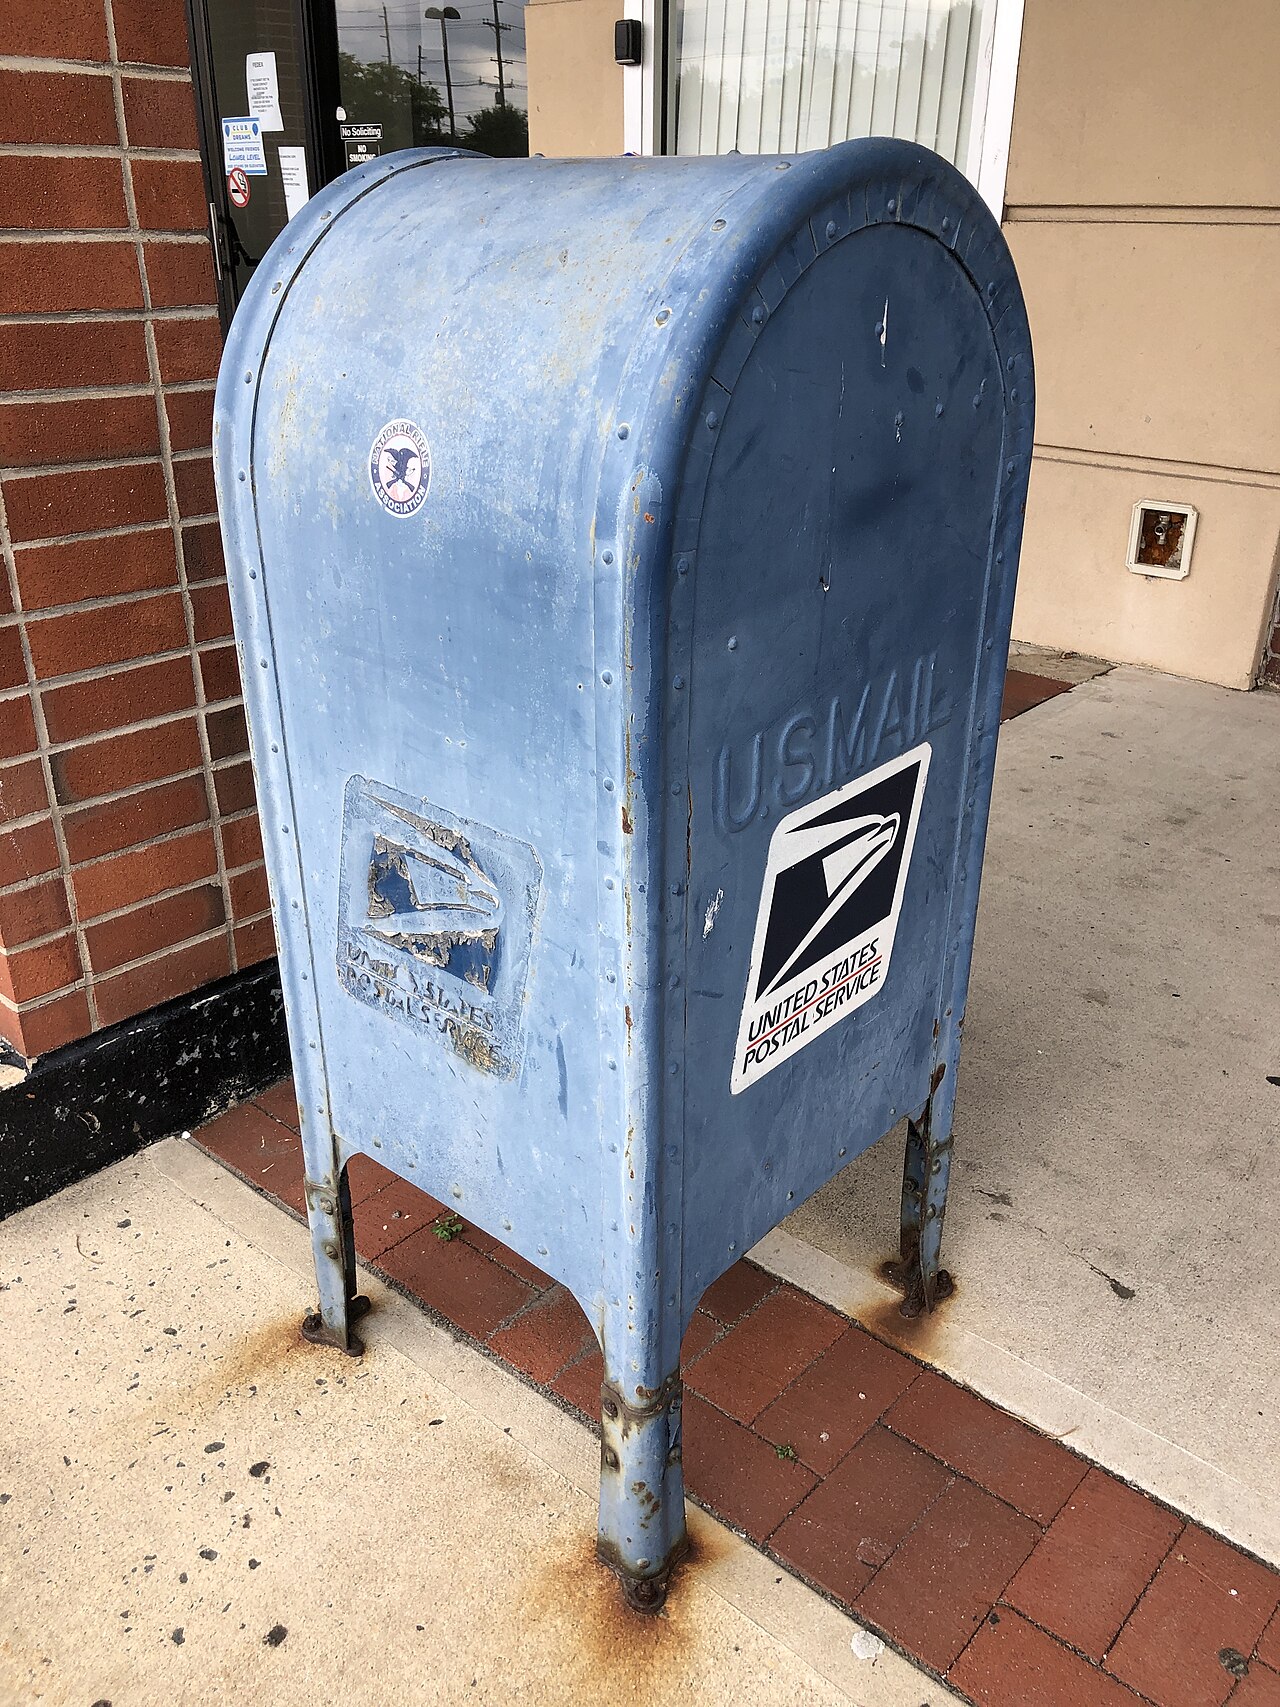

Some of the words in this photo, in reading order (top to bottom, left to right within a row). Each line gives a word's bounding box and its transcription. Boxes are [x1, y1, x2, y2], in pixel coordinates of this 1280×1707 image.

[342, 128, 351, 136] No
[351, 127, 381, 138] Soliciting
[357, 145, 367, 153] NO
[372, 424, 411, 465] NATIONAL
[412, 430, 429, 467] RIFLE
[374, 482, 426, 514] ASSOCIATION
[748, 979, 819, 1042] UNITED
[819, 937, 879, 994] STATES
[742, 1011, 810, 1075] POSTAL
[813, 960, 882, 1024] SERVICE
